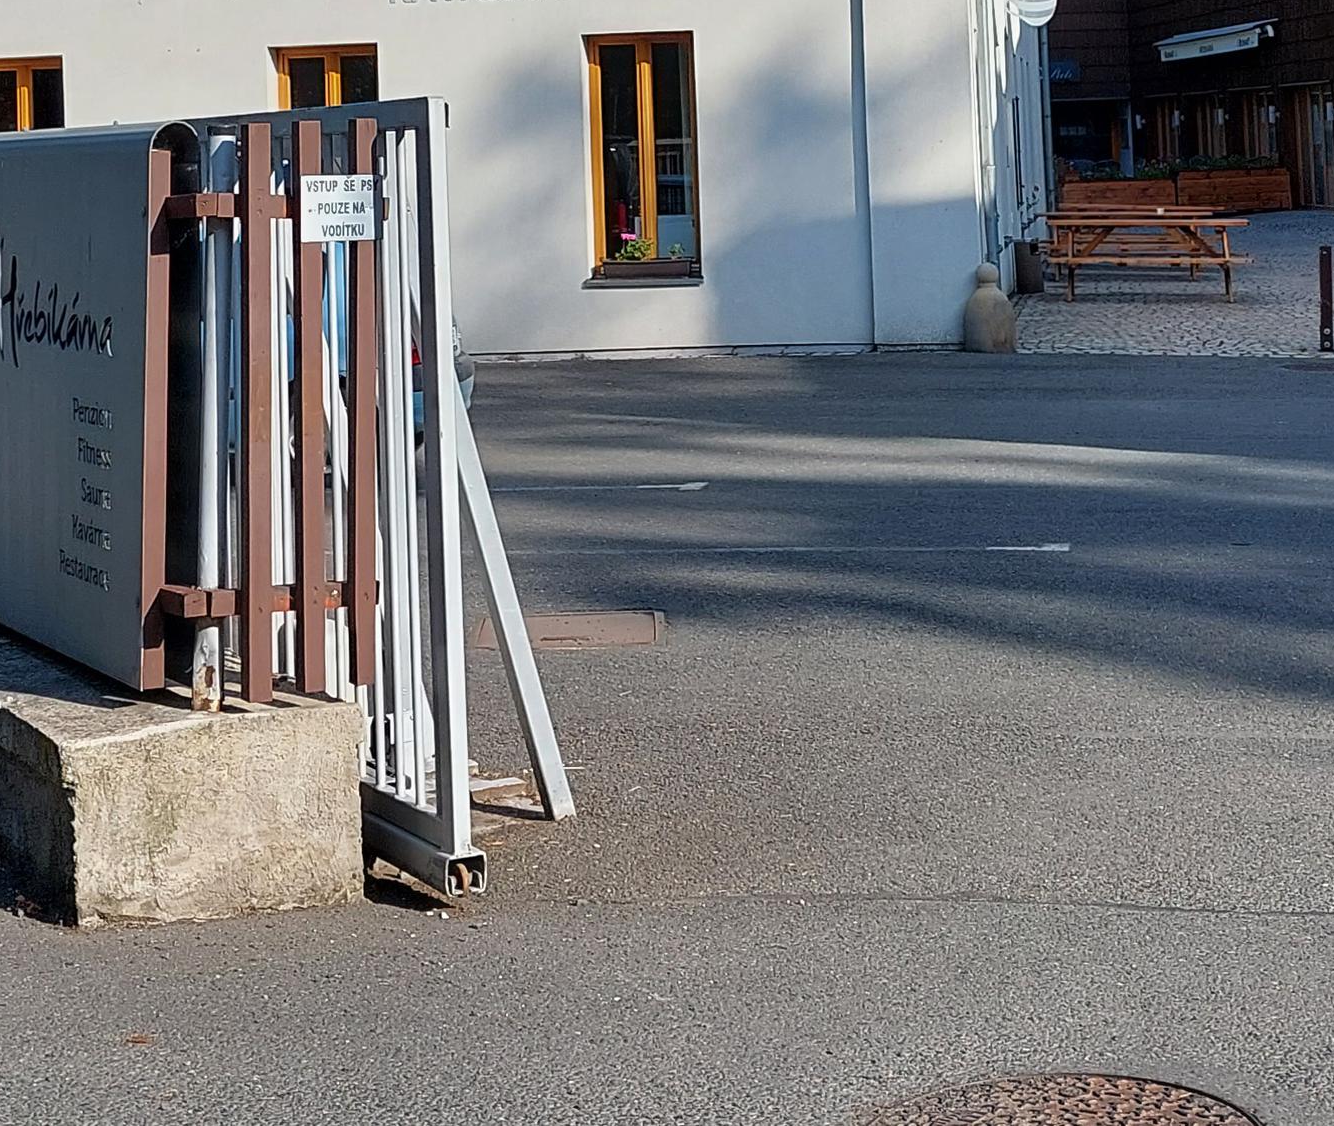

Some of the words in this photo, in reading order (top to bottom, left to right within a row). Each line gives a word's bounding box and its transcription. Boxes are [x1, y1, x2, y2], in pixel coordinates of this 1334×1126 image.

[306, 180, 338, 193] VSTUP
[343, 179, 356, 192] SE
[361, 178, 379, 192] PSY
[317, 202, 350, 214] POUZE
[352, 201, 366, 214] NA
[321, 221, 365, 237] VODÍTKU
[72, 397, 112, 429] Penzion
[77, 437, 112, 470] Fitness
[80, 477, 112, 510] Sauna
[71, 514, 112, 550] Kavárna
